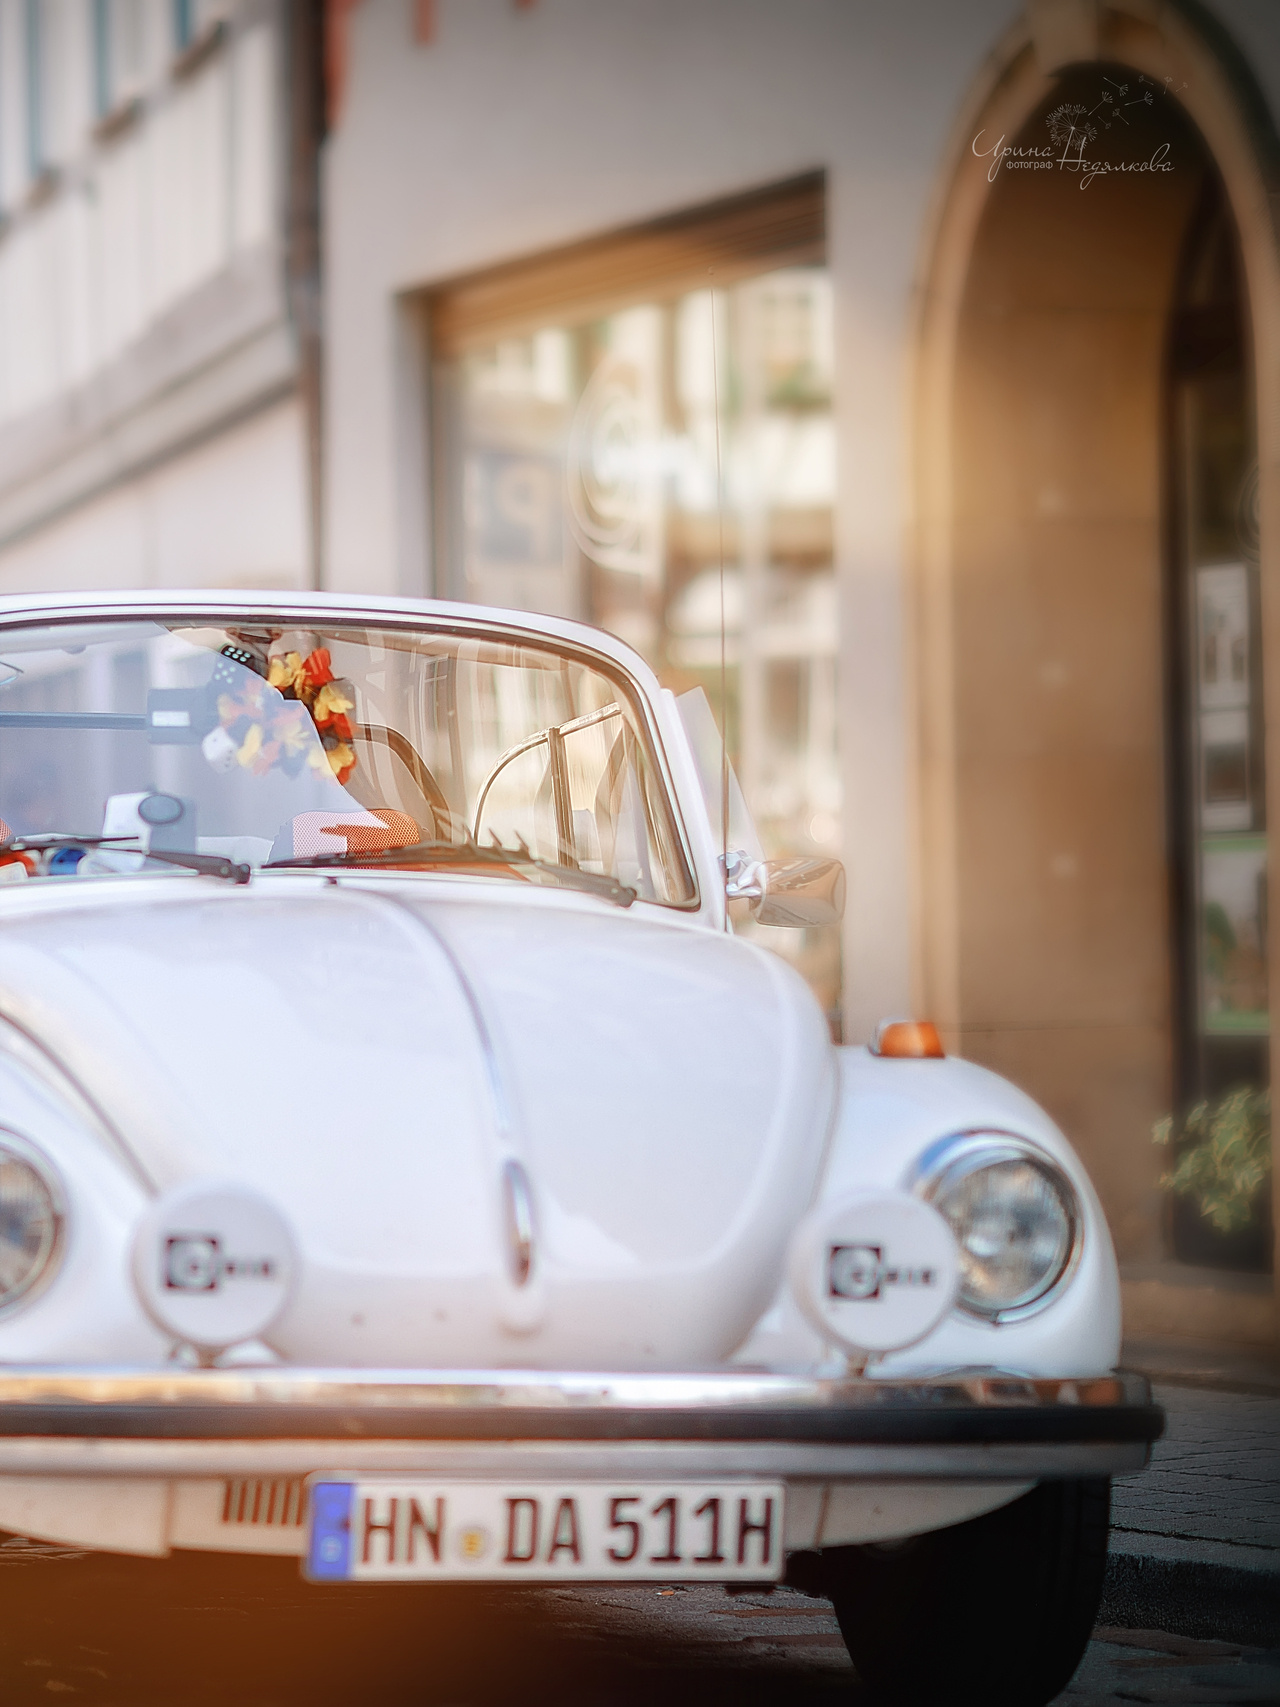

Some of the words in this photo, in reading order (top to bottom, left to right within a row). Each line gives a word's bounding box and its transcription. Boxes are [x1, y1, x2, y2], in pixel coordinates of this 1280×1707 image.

[361, 1497, 446, 1565] HN
[502, 1497, 582, 1565] DA
[607, 1497, 775, 1565] 511H
